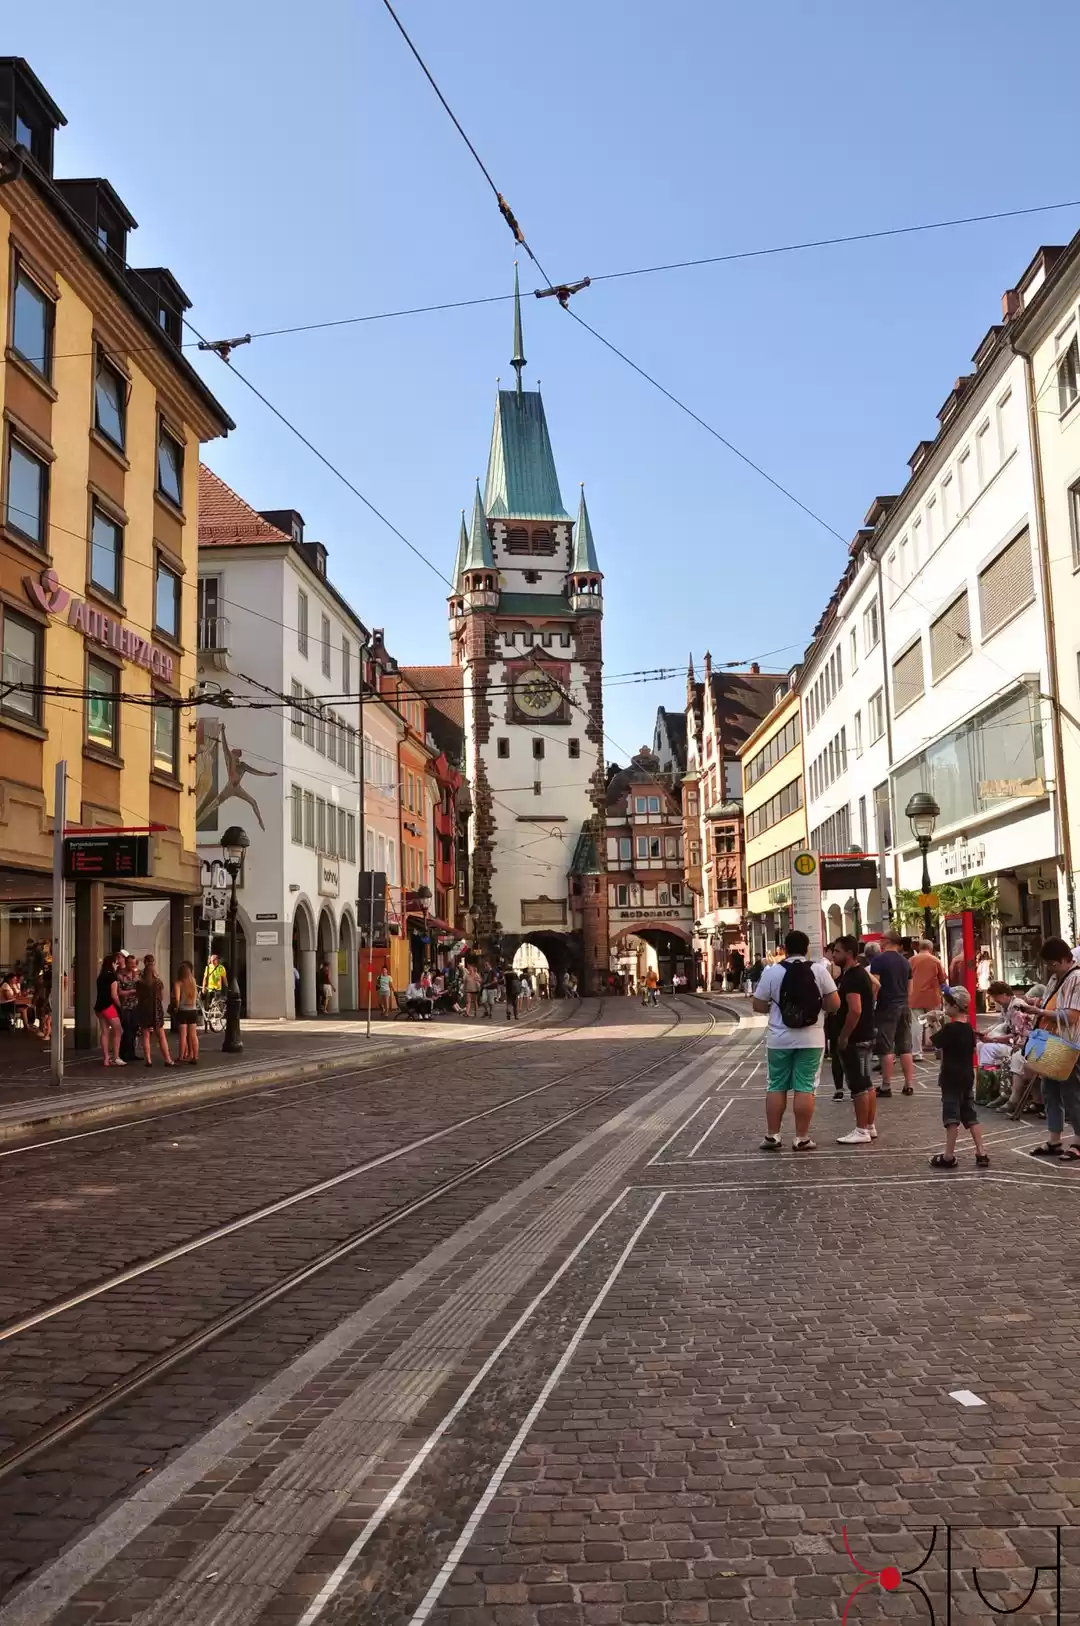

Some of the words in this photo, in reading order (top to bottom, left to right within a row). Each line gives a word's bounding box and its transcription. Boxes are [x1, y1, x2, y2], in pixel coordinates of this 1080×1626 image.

[69, 600, 108, 647] ALTE
[110, 619, 173, 684] LEIPZIGER
[1036, 879, 1059, 891] Sch
[620, 909, 680, 919] McDonald's
